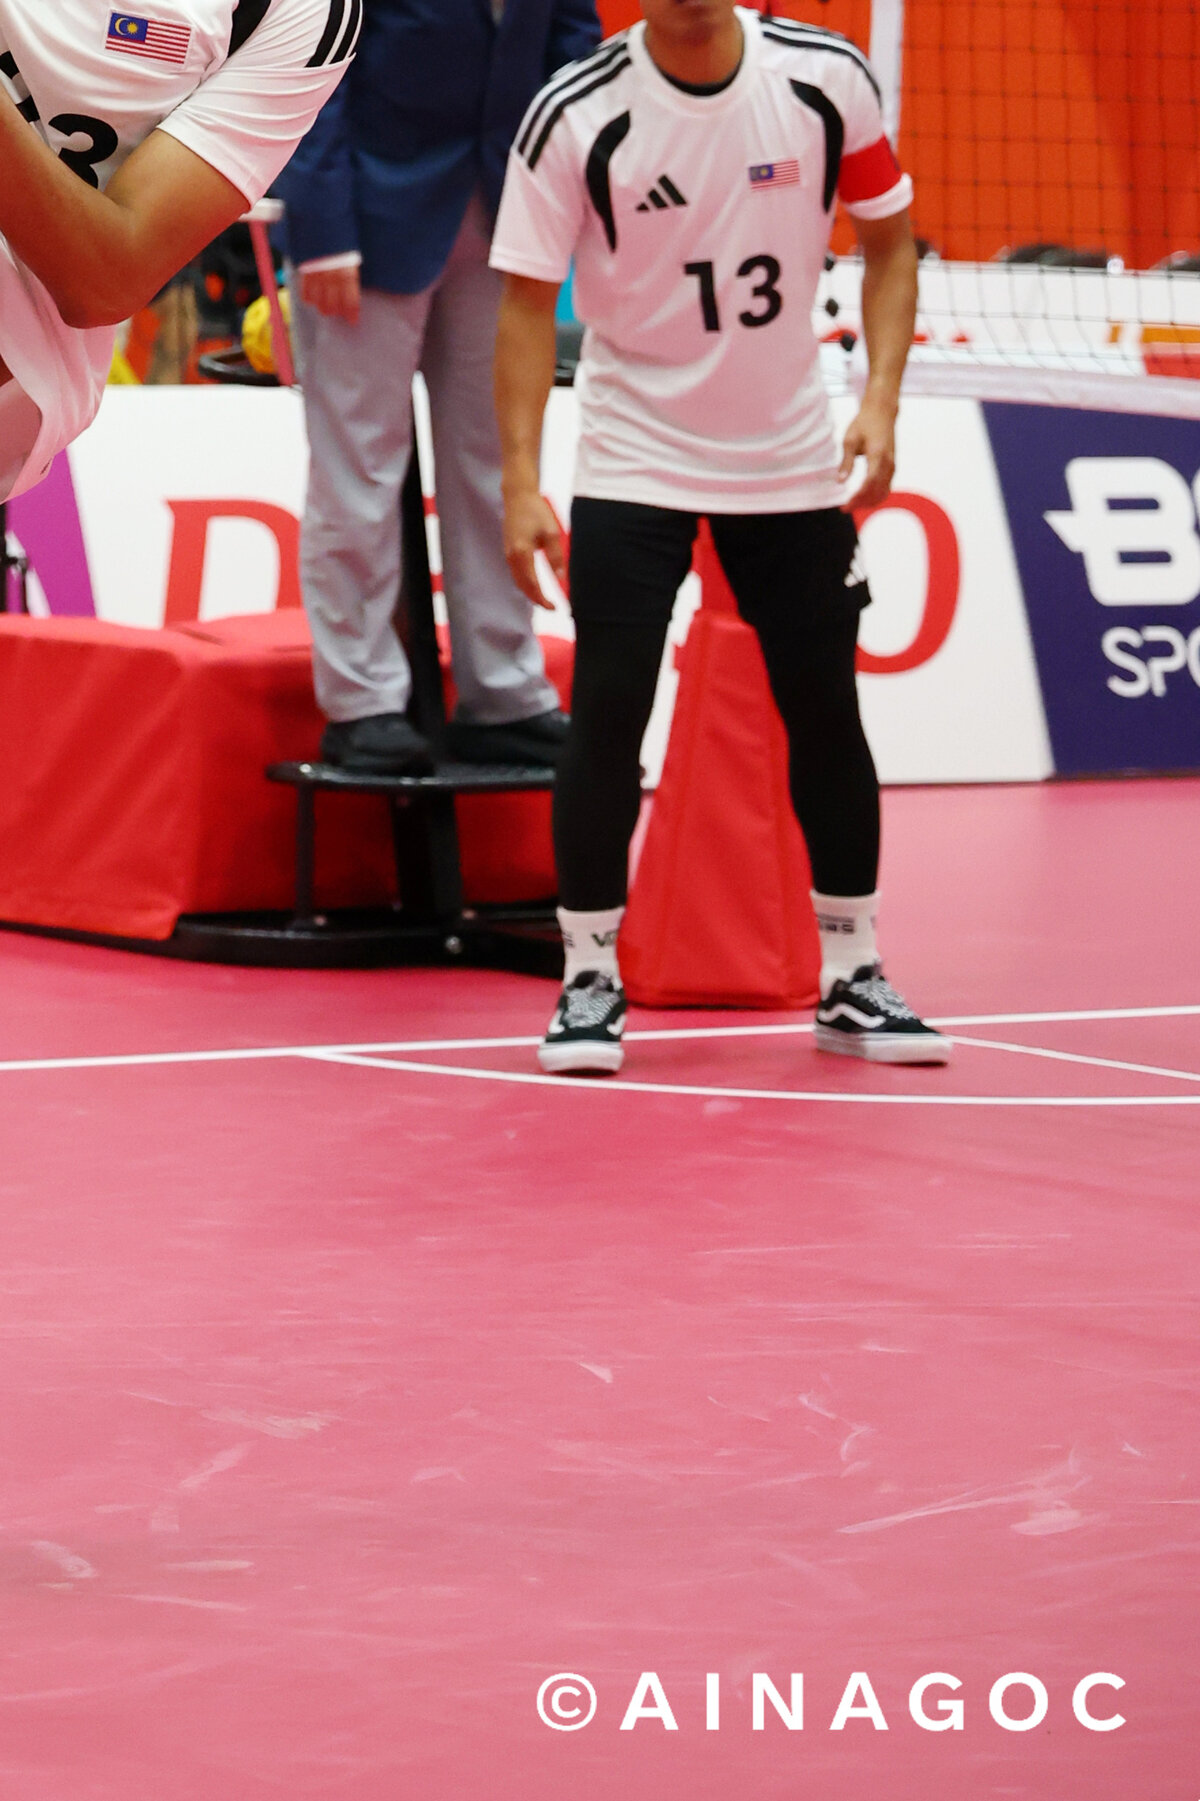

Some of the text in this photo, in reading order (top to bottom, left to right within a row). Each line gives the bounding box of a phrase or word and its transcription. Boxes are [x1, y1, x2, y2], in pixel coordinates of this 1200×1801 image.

[683, 254, 783, 332] 13
[1043, 456, 1200, 606] B
[1101, 624, 1200, 698] SP
